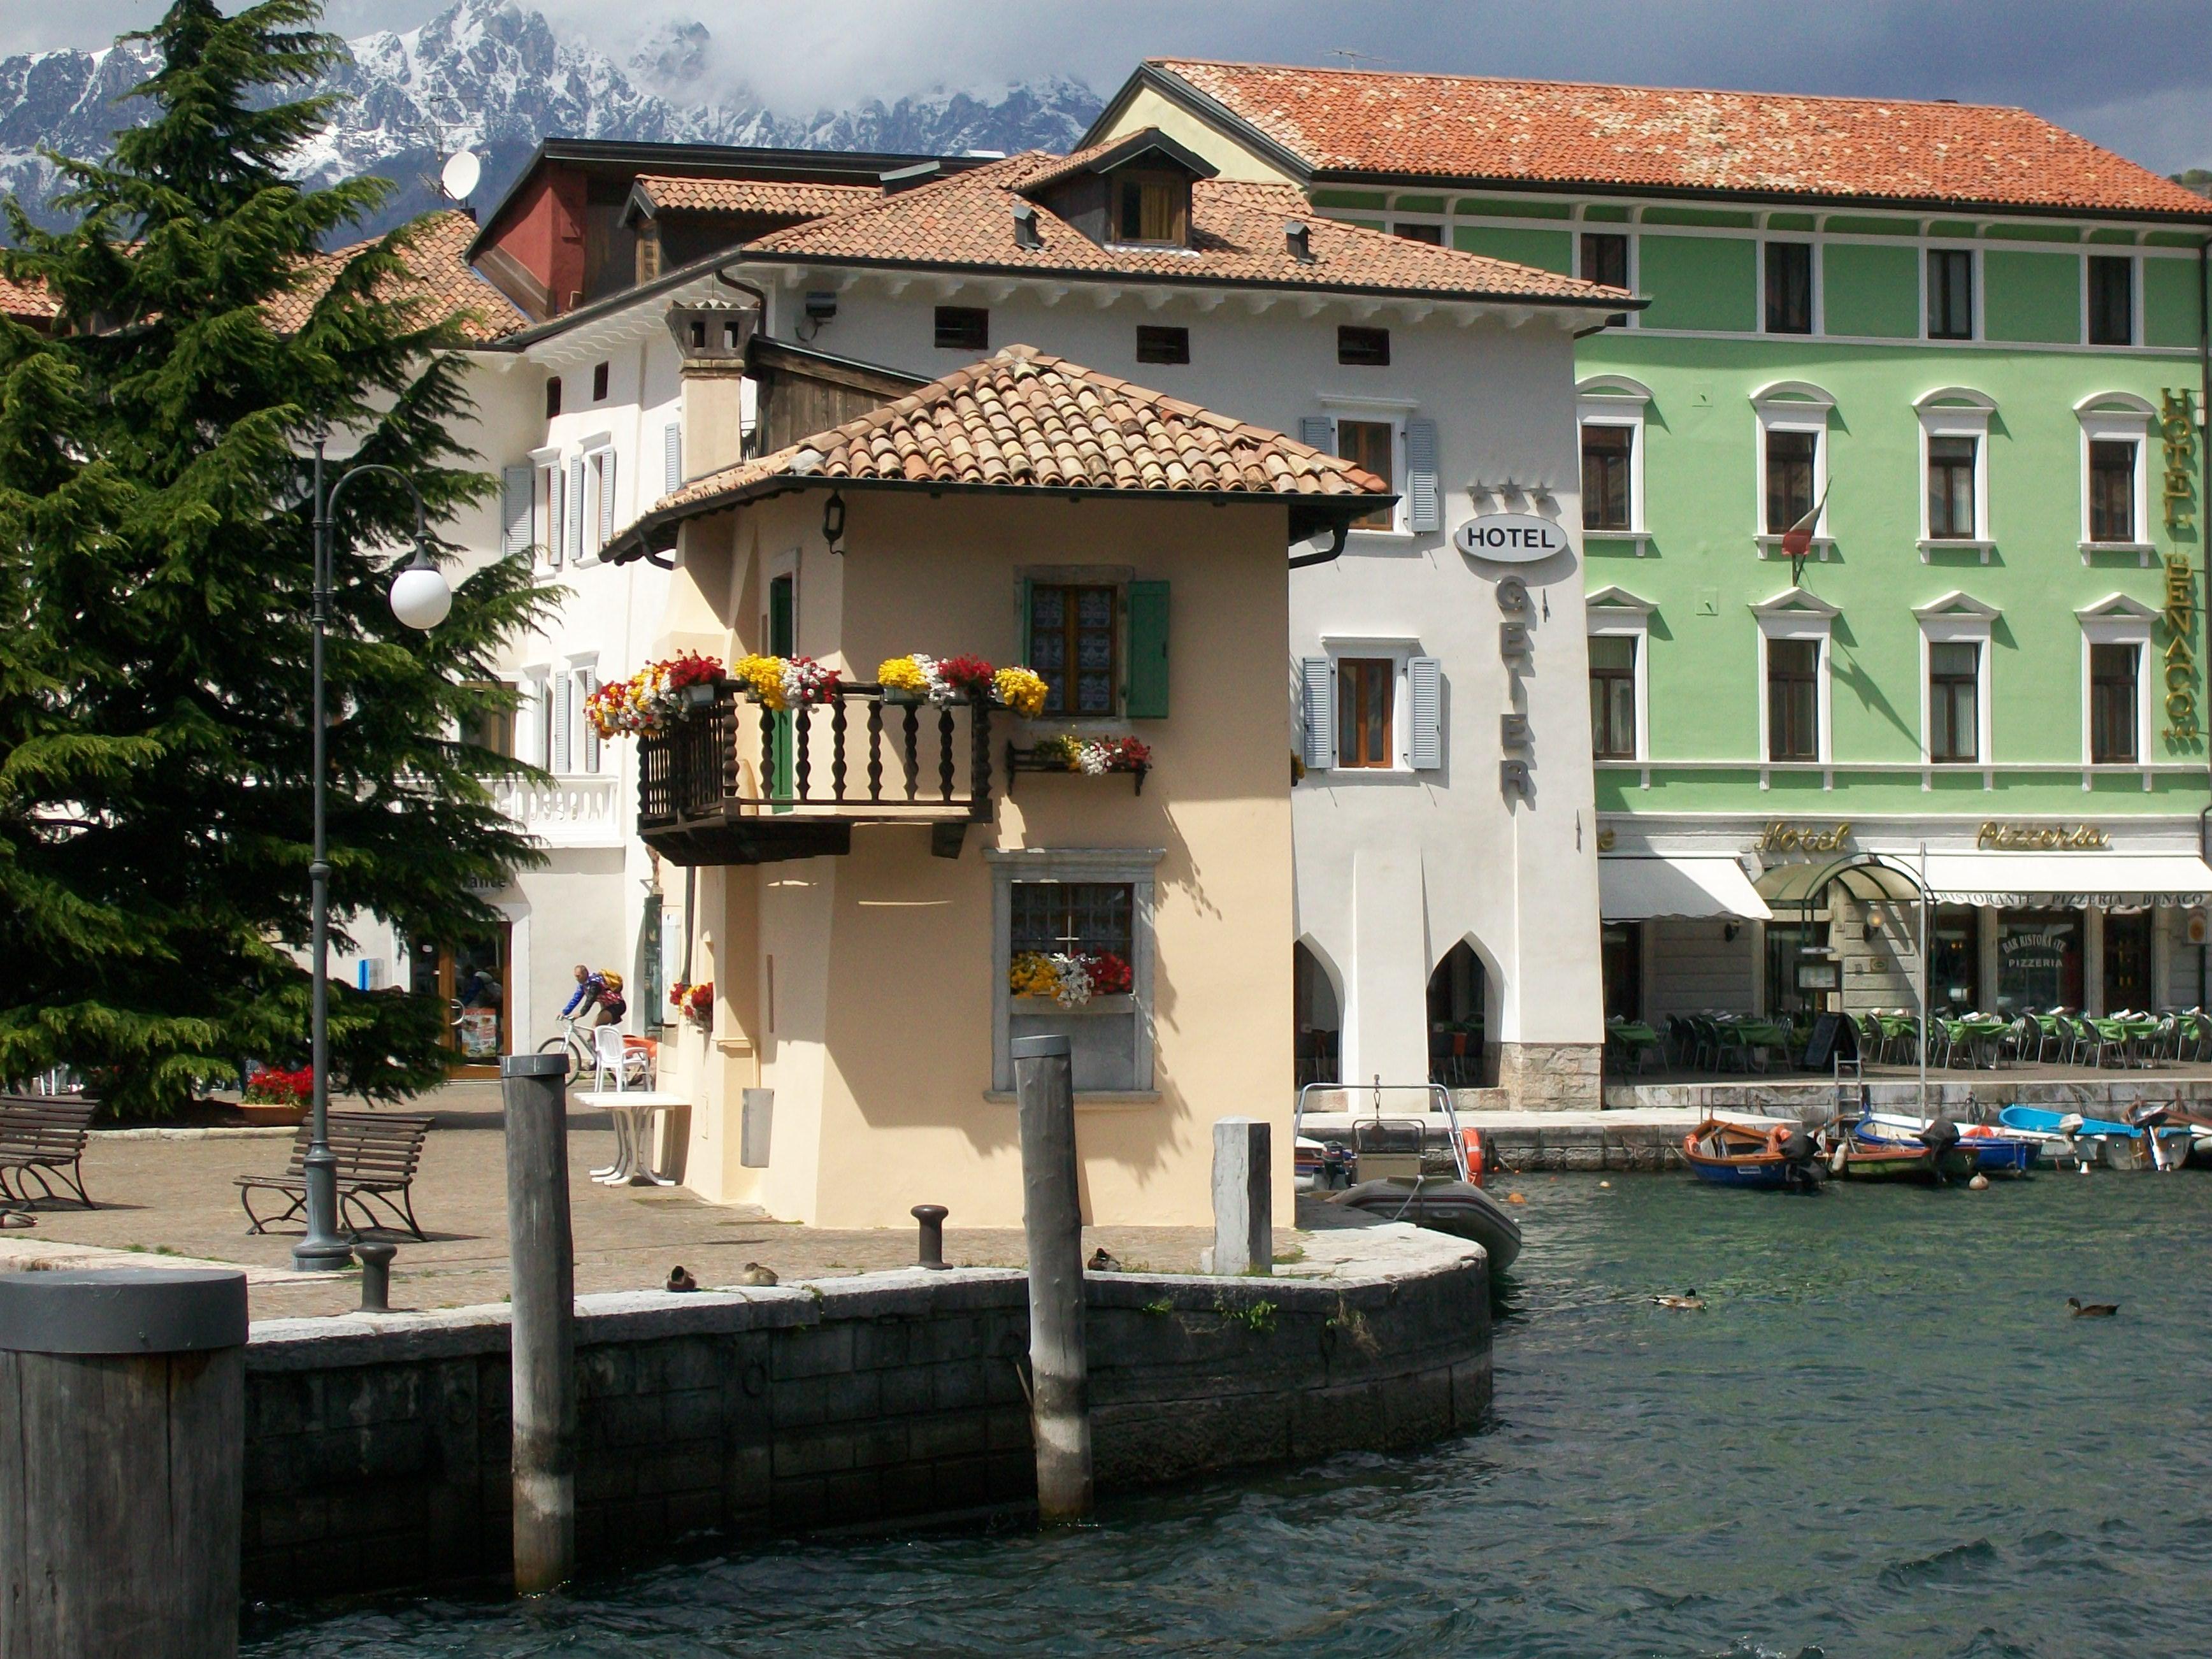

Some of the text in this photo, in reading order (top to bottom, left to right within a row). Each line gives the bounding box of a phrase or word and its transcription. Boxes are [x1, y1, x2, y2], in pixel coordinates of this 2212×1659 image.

[1467, 528, 1555, 548] HOTEL
[2161, 387, 2194, 717] HOTEL BENACO
[1495, 575, 1528, 794] GEIER
[1754, 822, 1850, 851] Hotel
[1978, 821, 2111, 851] Pizzeria
[1939, 893, 2203, 905] RISTORANTE PIZZERIA BENACO
[2002, 938, 2019, 954] BAR
[2008, 958, 2063, 968] PIZZERIA
